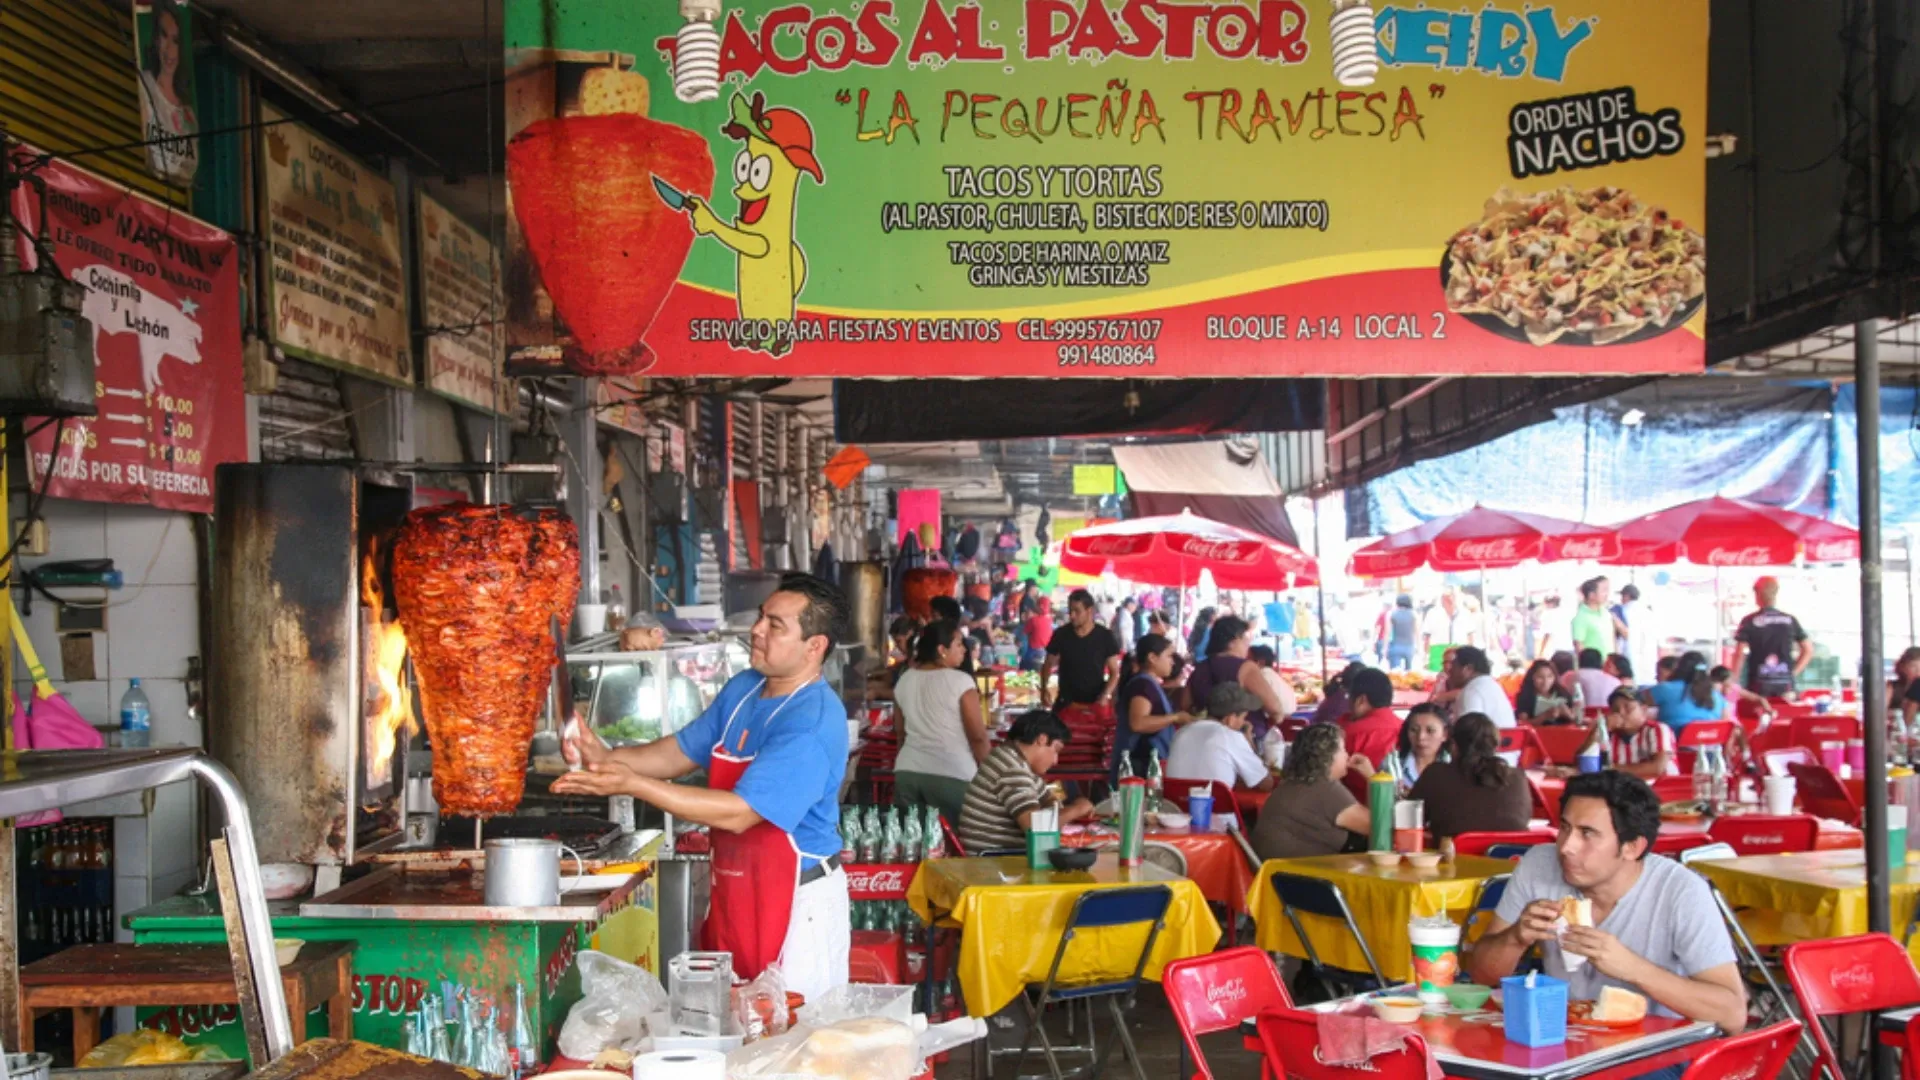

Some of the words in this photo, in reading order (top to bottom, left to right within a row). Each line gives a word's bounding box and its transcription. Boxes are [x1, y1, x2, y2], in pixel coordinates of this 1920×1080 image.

[908, 0, 1003, 62] AL
[1026, 0, 1307, 63] PASTOR
[940, 78, 1166, 145] PEQUEÑA
[1513, 99, 1595, 137] ORDEN
[1600, 93, 1630, 124] DE
[1514, 115, 1682, 174] NACHOS
[946, 167, 1032, 196] TACOS
[1038, 167, 1054, 196] Y
[1059, 167, 1162, 196] TORTAS
[882, 204, 913, 231] (AL
[916, 204, 992, 232] PASTOR,
[997, 204, 1087, 231] CHULETA,
[1095, 203, 1169, 229] BISTECK
[1170, 203, 1200, 229] DE
[1203, 202, 1239, 228] RES
[1241, 202, 1257, 228] O
[1260, 201, 1329, 230] MIXTO)
[57, 227, 73, 246] LE
[948, 242, 1005, 264] TACOS
[1008, 242, 1034, 264] DE
[1036, 242, 1102, 265] HARINA
[1105, 242, 1120, 264] O
[1123, 242, 1169, 264] MAIZ
[969, 264, 1047, 286] GRINGAS
[1048, 264, 1063, 286] Y
[1065, 264, 1150, 286] MESTIZAS
[690, 319, 773, 341] SERVICIO
[775, 319, 823, 341] PARA
[829, 319, 898, 341] FIESTAS
[899, 319, 915, 341] Y
[917, 319, 1001, 341] EVENTOS
[1017, 319, 1163, 341] CEL:9995767107
[1206, 317, 1288, 340] BLOQUE
[1296, 317, 1341, 340] A-14
[1355, 315, 1422, 339] LOCAL
[1432, 313, 1448, 340] 2
[1057, 345, 1156, 366] 991480864
[91, 460, 123, 485] POR
[127, 465, 148, 486] SU
[847, 870, 905, 893] oca-Cola
[352, 974, 424, 1016] STOR
